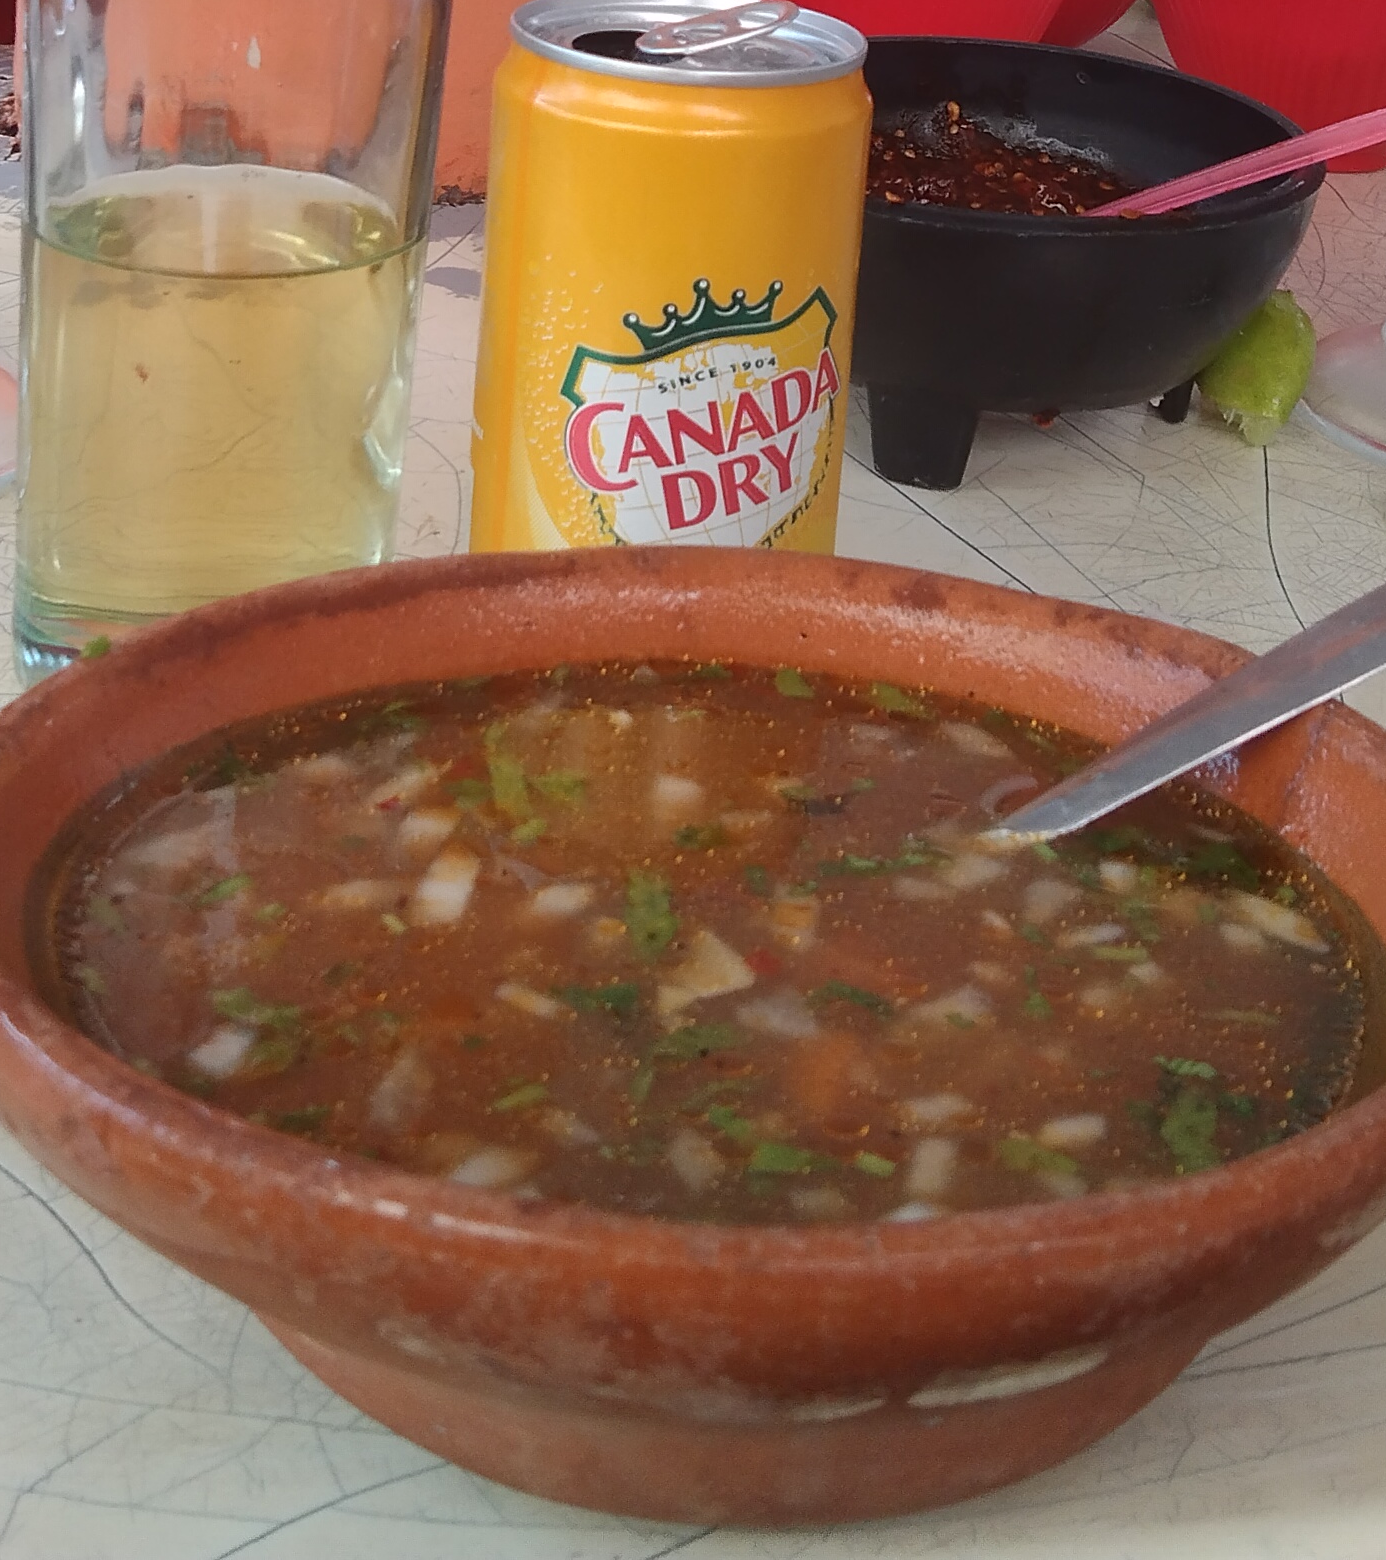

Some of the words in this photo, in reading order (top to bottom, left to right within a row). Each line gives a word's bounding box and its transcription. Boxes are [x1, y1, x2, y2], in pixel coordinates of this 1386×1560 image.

[568, 348, 841, 493] CANADA
[657, 367, 720, 394] SINCE
[730, 356, 778, 373] 1904
[660, 431, 800, 531] DRY
